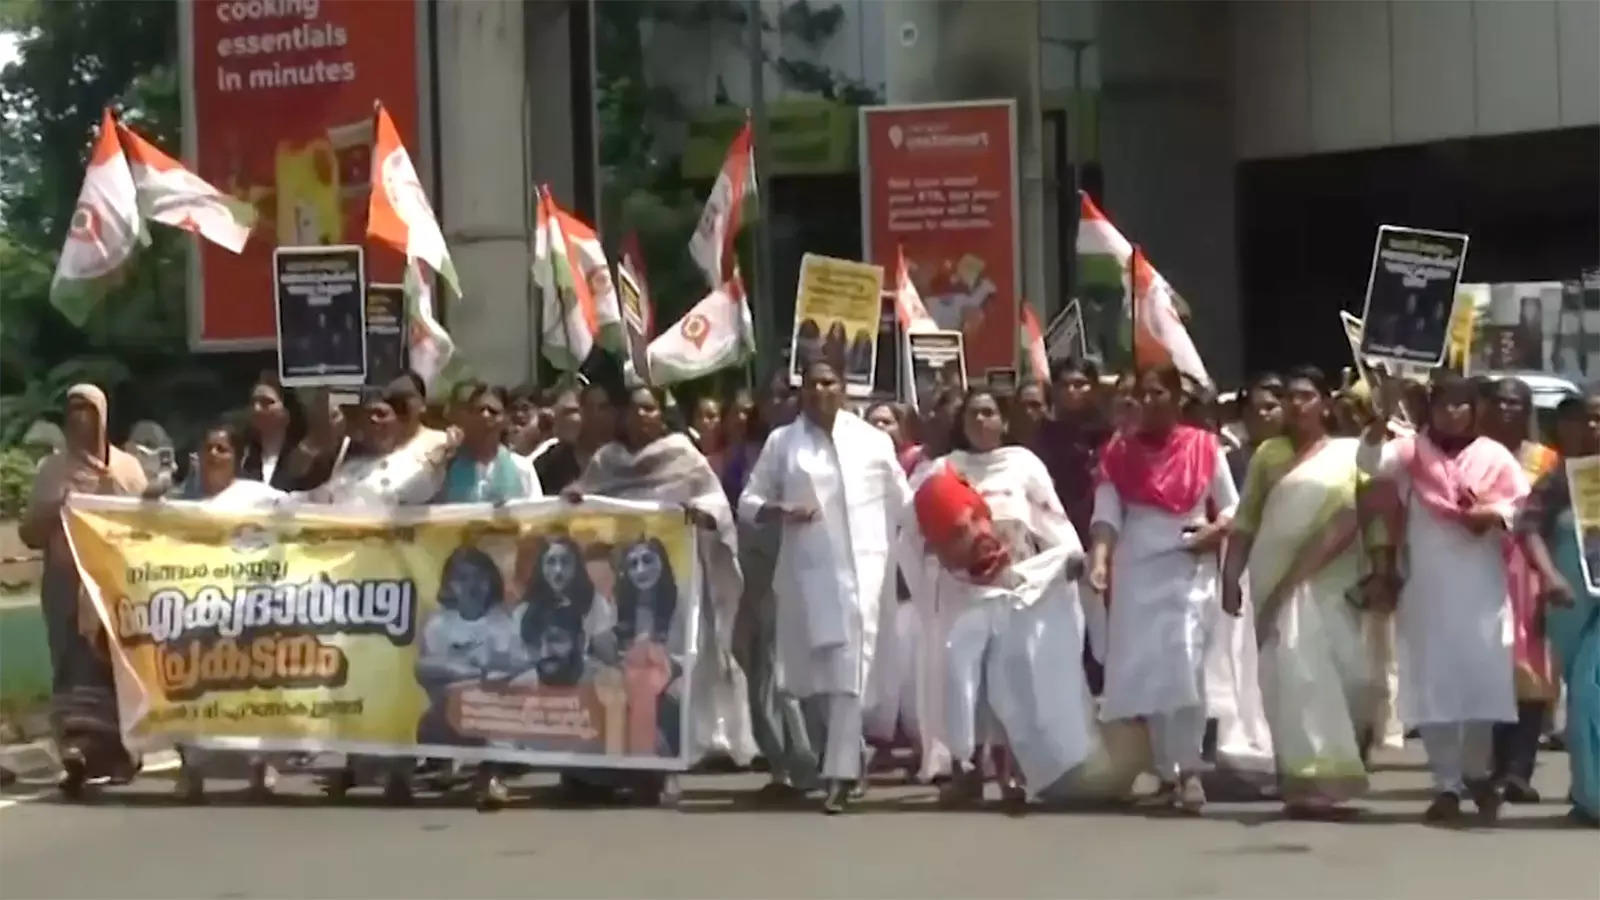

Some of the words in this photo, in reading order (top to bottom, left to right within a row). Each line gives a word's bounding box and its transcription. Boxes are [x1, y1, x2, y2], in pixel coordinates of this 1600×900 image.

[217, 0, 320, 22] cooking
[217, 23, 348, 57] essentials
[249, 60, 355, 89] minutes
